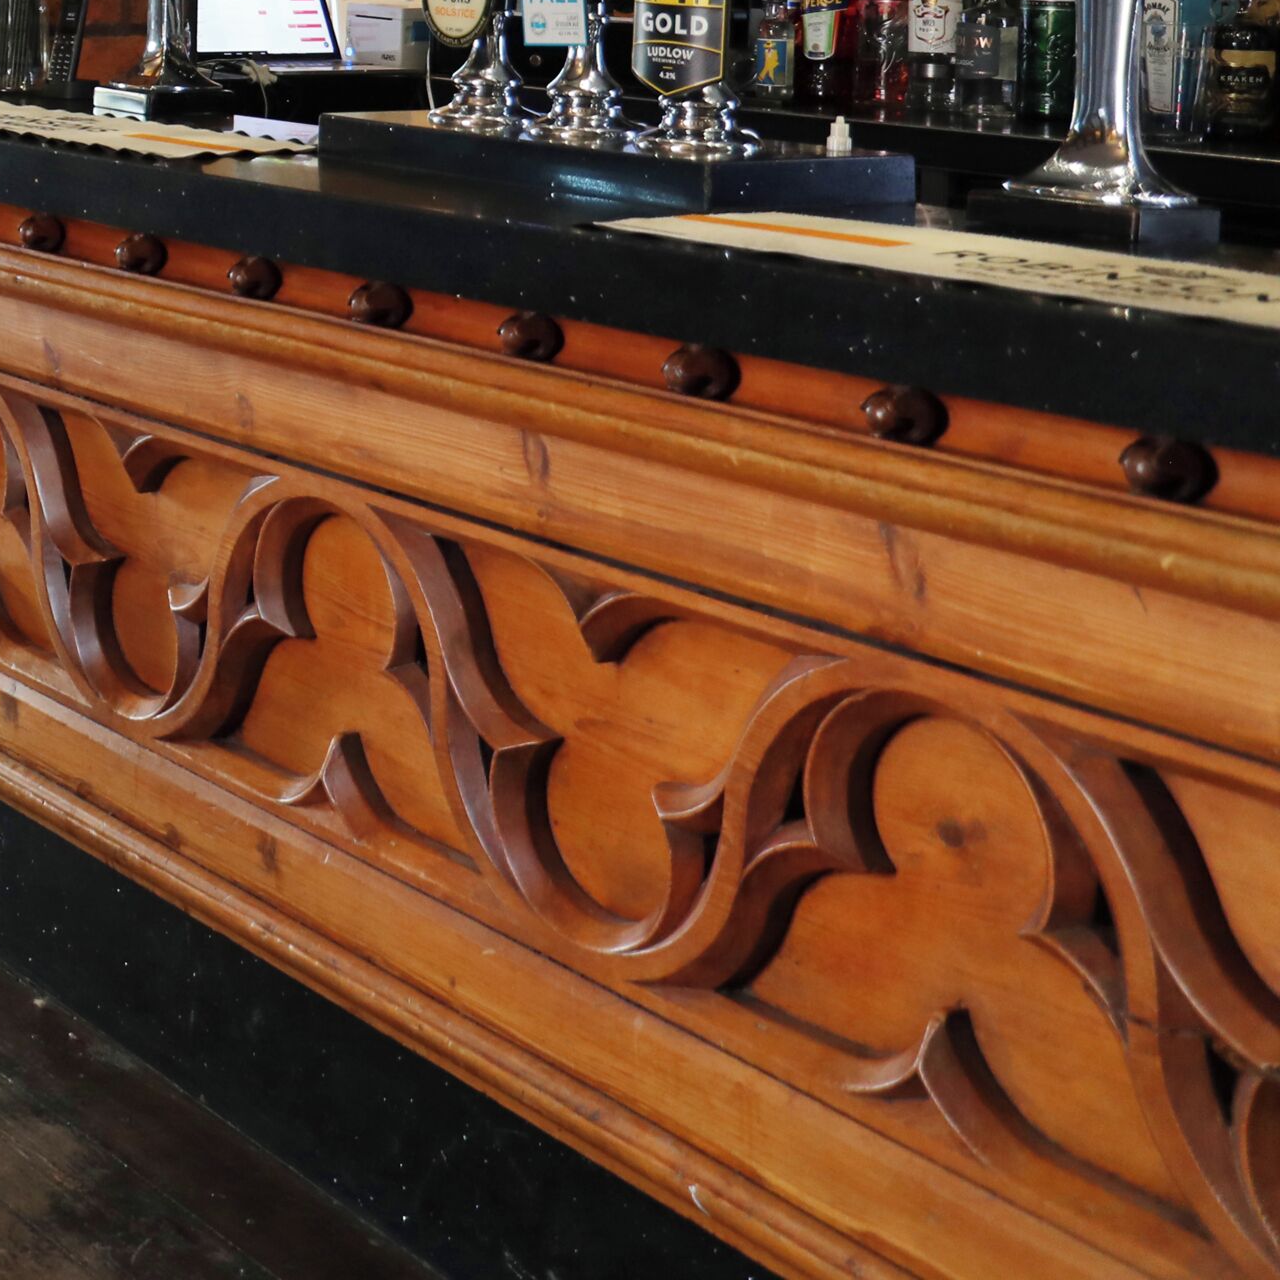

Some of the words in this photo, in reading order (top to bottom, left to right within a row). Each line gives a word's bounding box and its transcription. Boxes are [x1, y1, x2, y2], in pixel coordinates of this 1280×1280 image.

[434, 6, 477, 19] SOLSTICE
[641, 11, 709, 37] GOLD
[646, 46, 695, 61] LUDLOW
[658, 70, 676, 81] 4.2%
[1220, 74, 1263, 84] KRAKEN
